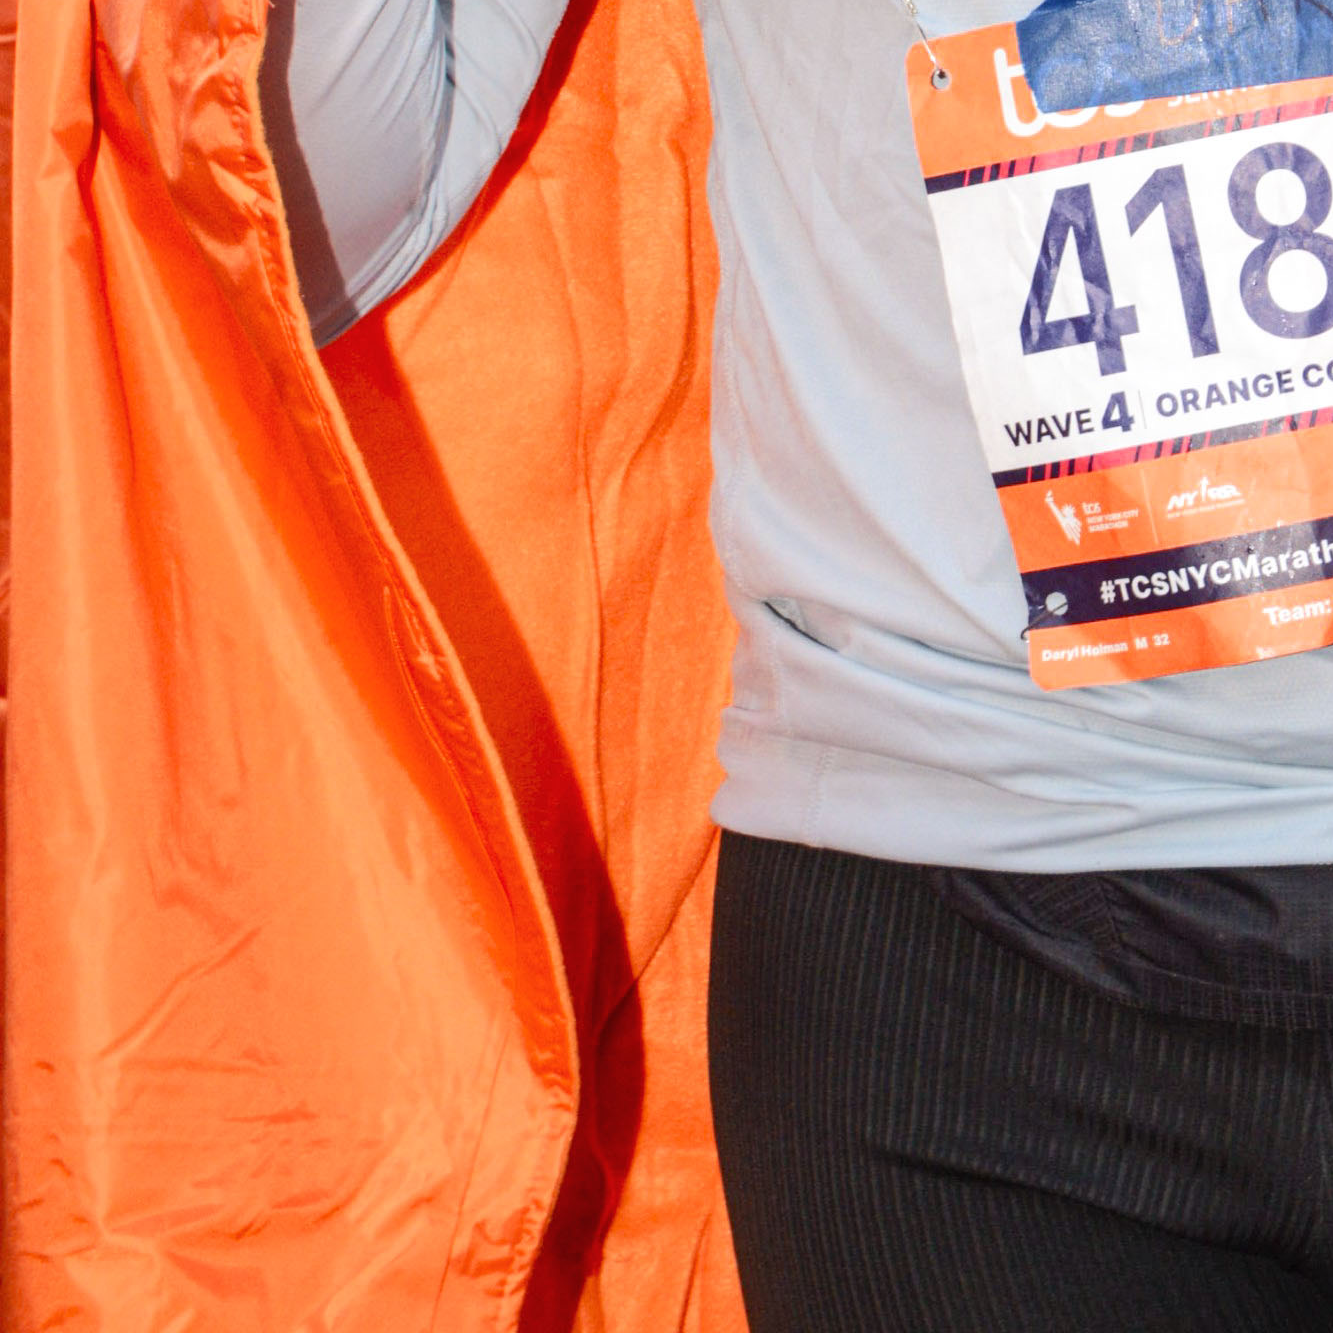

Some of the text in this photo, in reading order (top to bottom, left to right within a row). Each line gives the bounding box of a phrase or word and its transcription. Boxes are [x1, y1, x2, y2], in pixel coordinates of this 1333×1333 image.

[1156, 369, 1295, 417] ORANGE
[1004, 391, 1135, 447] WAVE 4
[1262, 599, 1331, 626] Team:
[1041, 634, 1170, 662] Daryl Holman M 32
